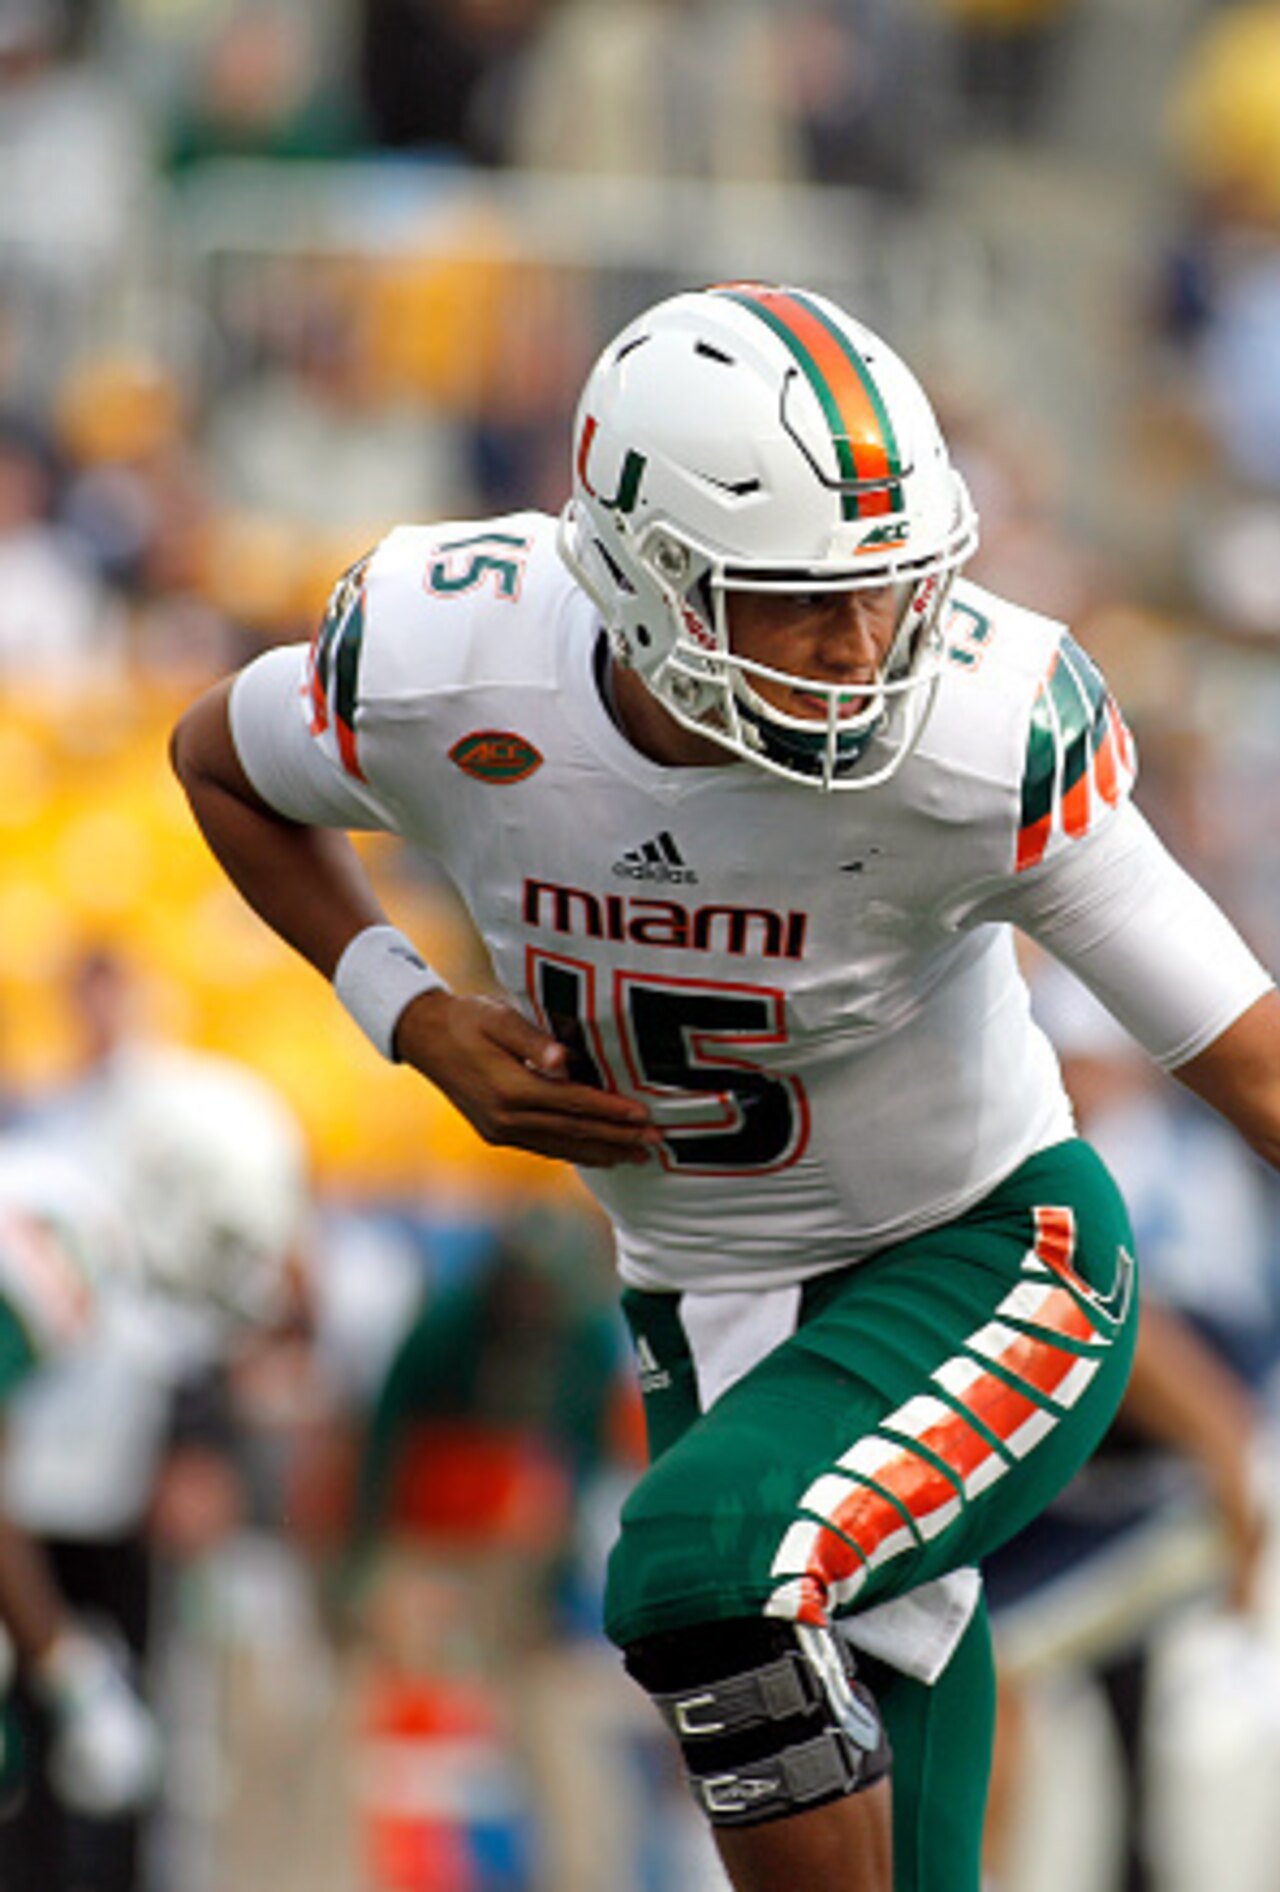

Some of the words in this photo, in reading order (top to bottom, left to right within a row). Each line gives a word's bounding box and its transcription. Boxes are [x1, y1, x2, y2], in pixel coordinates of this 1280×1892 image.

[857, 521, 910, 548] ACC
[424, 533, 536, 602] 15
[611, 861, 699, 885] adidas
[525, 944, 811, 1178] 15
